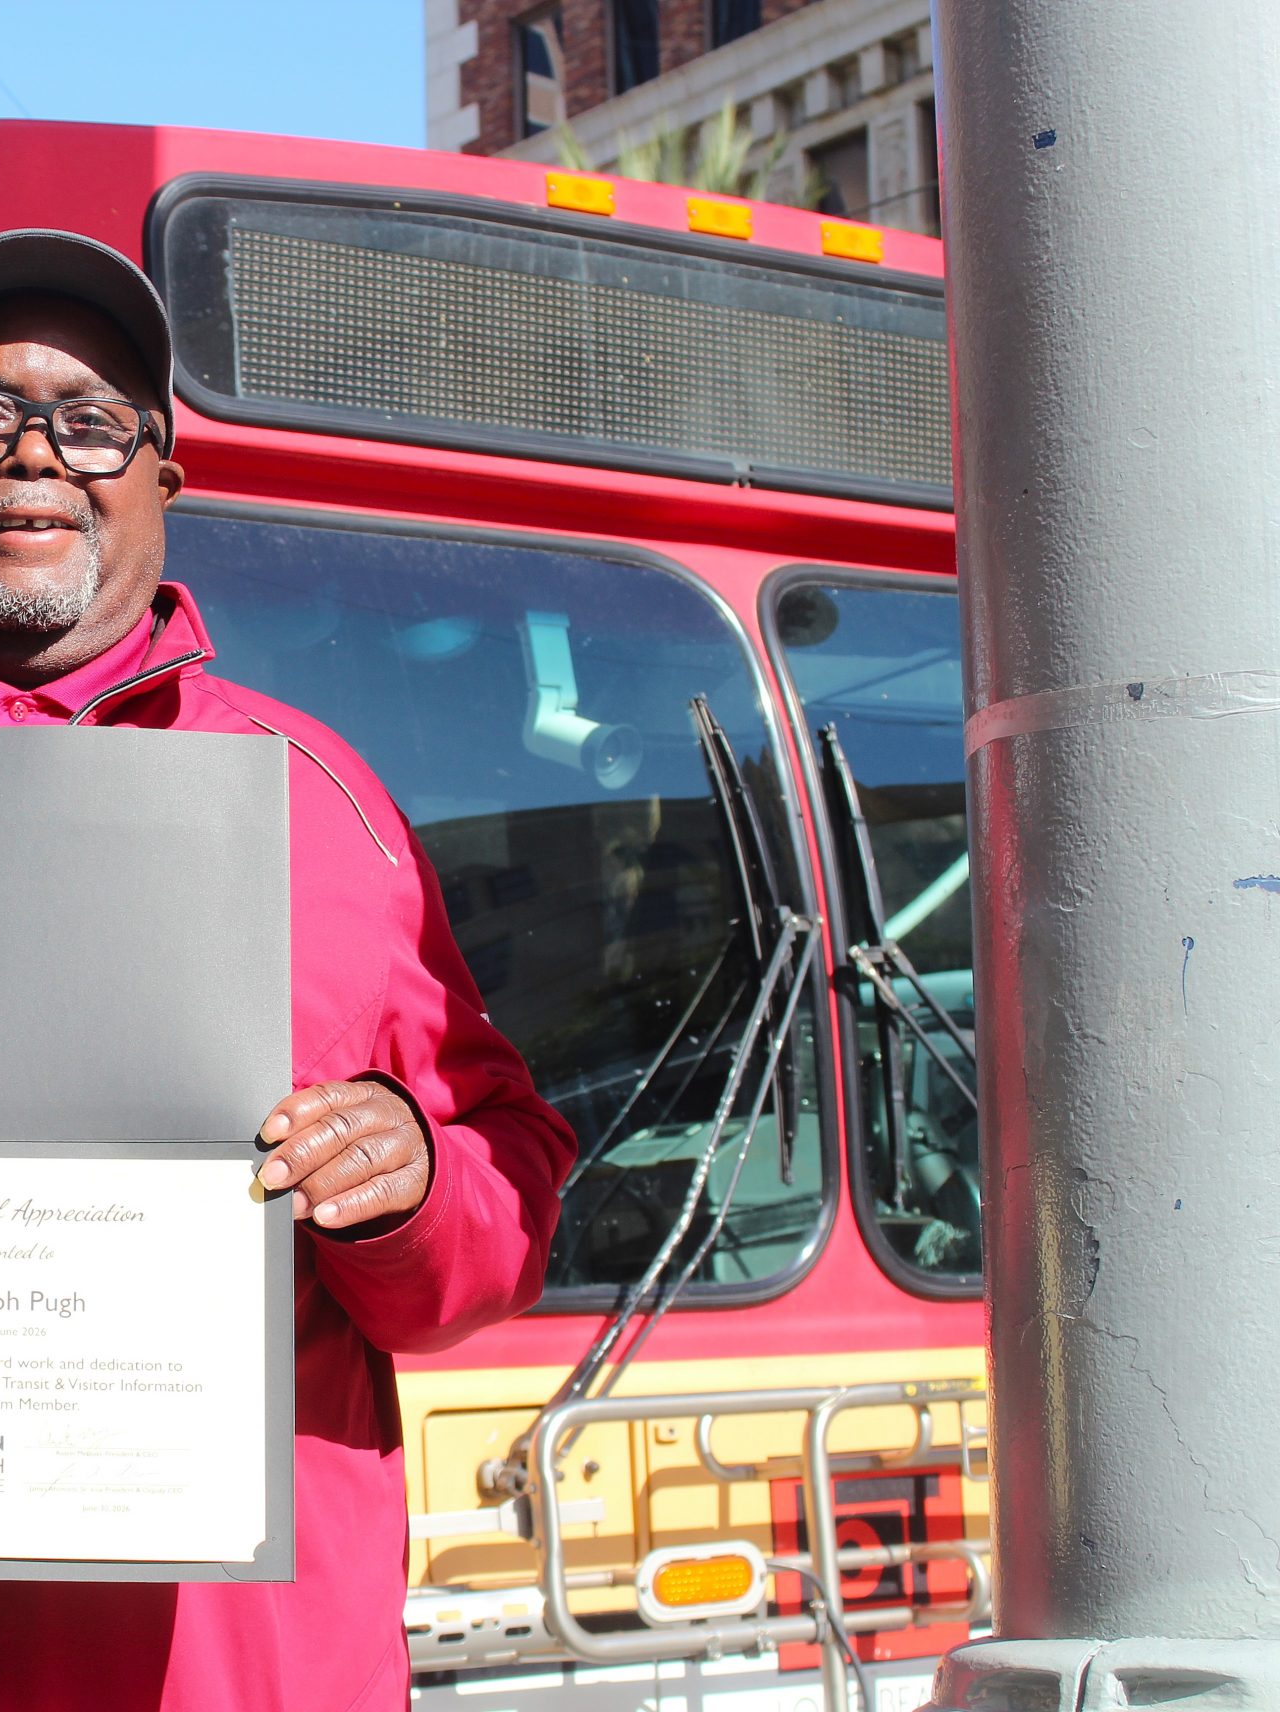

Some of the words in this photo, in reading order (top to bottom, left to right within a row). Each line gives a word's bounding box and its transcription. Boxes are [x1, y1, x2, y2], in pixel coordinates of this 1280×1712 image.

[11, 1197, 146, 1227] Appreciation
[38, 1245, 55, 1260] to
[31, 1290, 86, 1319] Pugh
[22, 1327, 47, 1337] 2026
[18, 1356, 54, 1370] work
[60, 1357, 84, 1370] and
[90, 1357, 162, 1371] dedication
[168, 1360, 183, 1372] to
[2, 1376, 50, 1390] Transit
[55, 1377, 65, 1390] &
[69, 1377, 115, 1391] Visitor
[120, 1379, 203, 1393] Information
[19, 1397, 80, 1411] Member.
